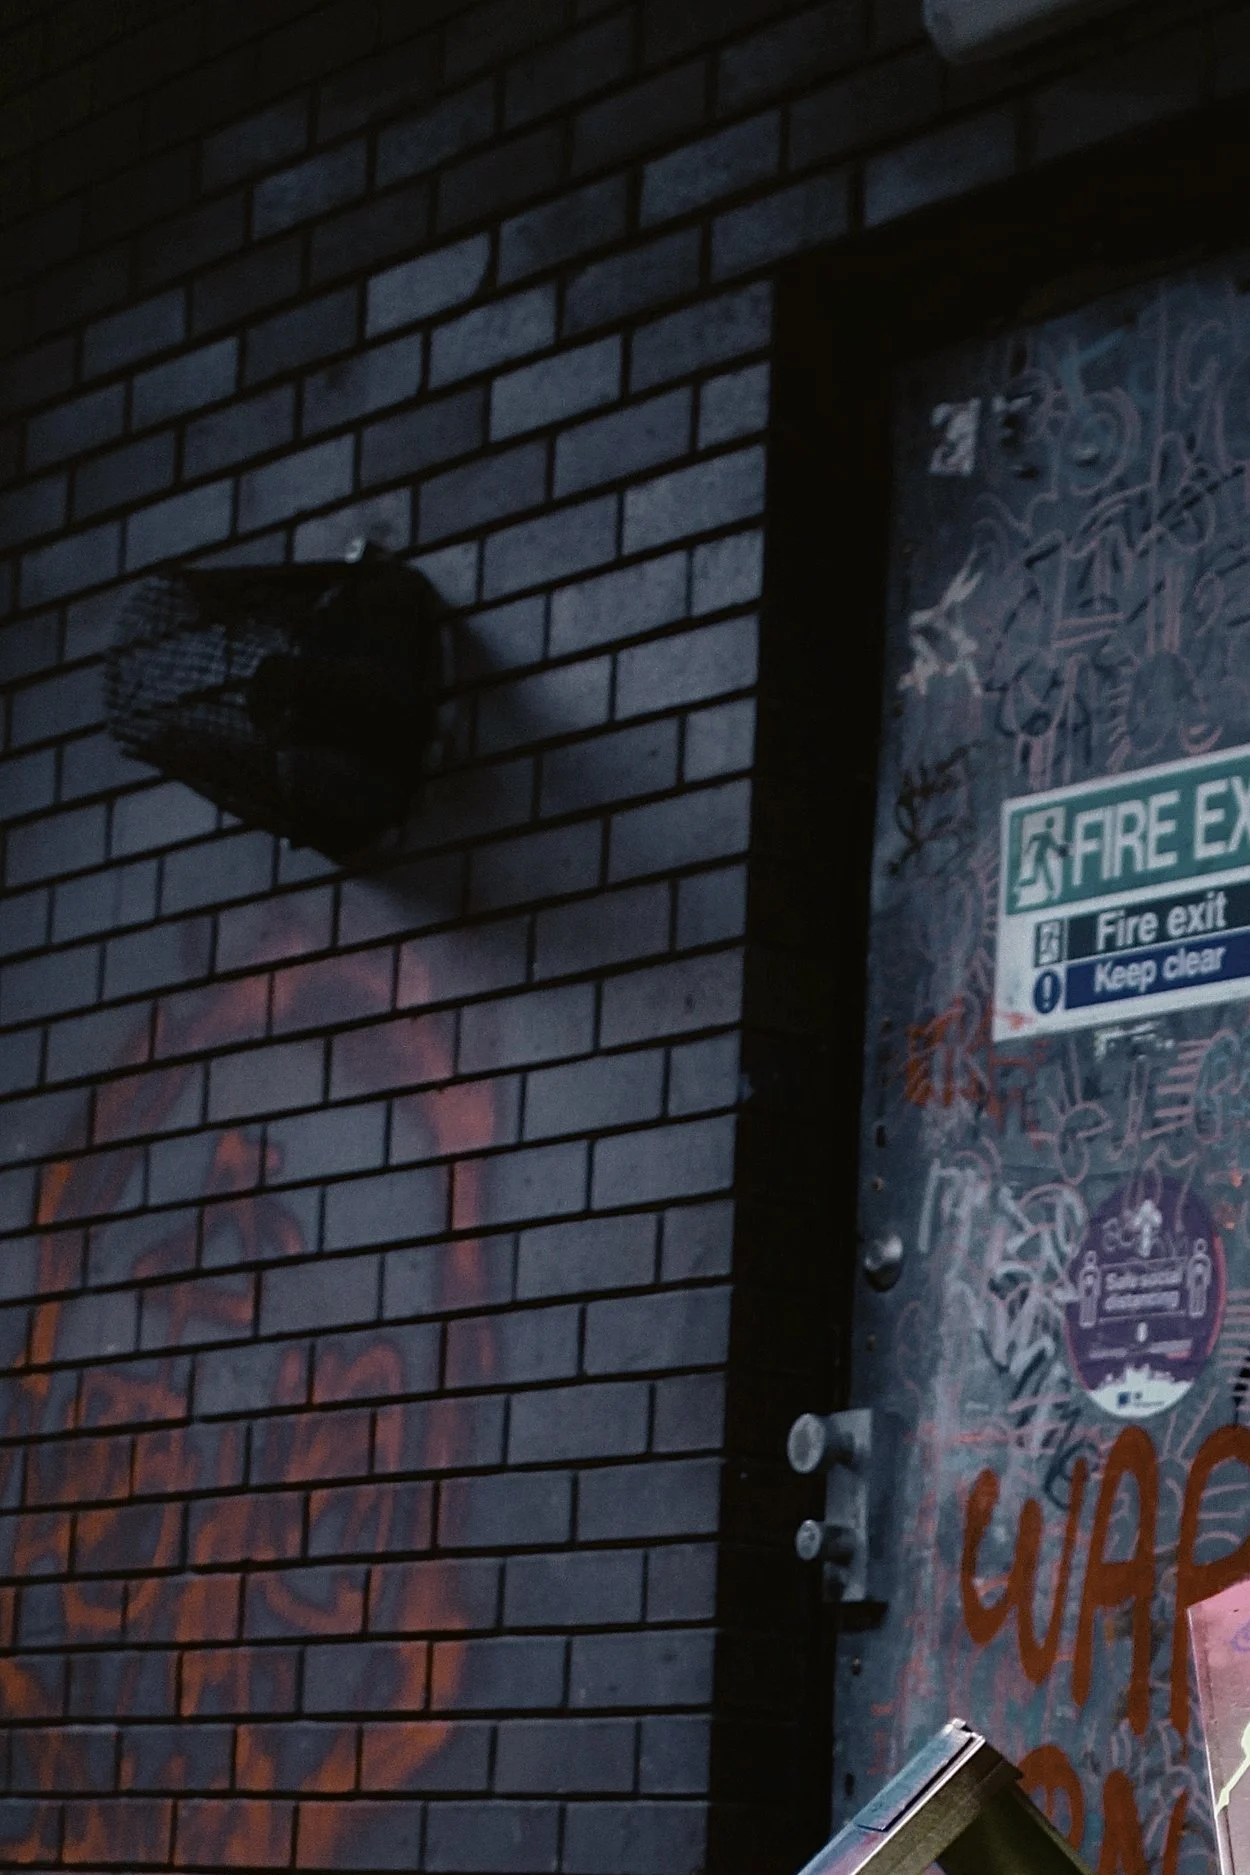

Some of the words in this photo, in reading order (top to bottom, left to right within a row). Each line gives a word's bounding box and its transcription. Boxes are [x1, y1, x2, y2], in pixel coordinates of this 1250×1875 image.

[1071, 790, 1181, 888] FIRE
[1097, 908, 1158, 951] Fire
[1166, 890, 1228, 939] exit
[1094, 959, 1157, 994] Keep
[1163, 945, 1227, 980] clear
